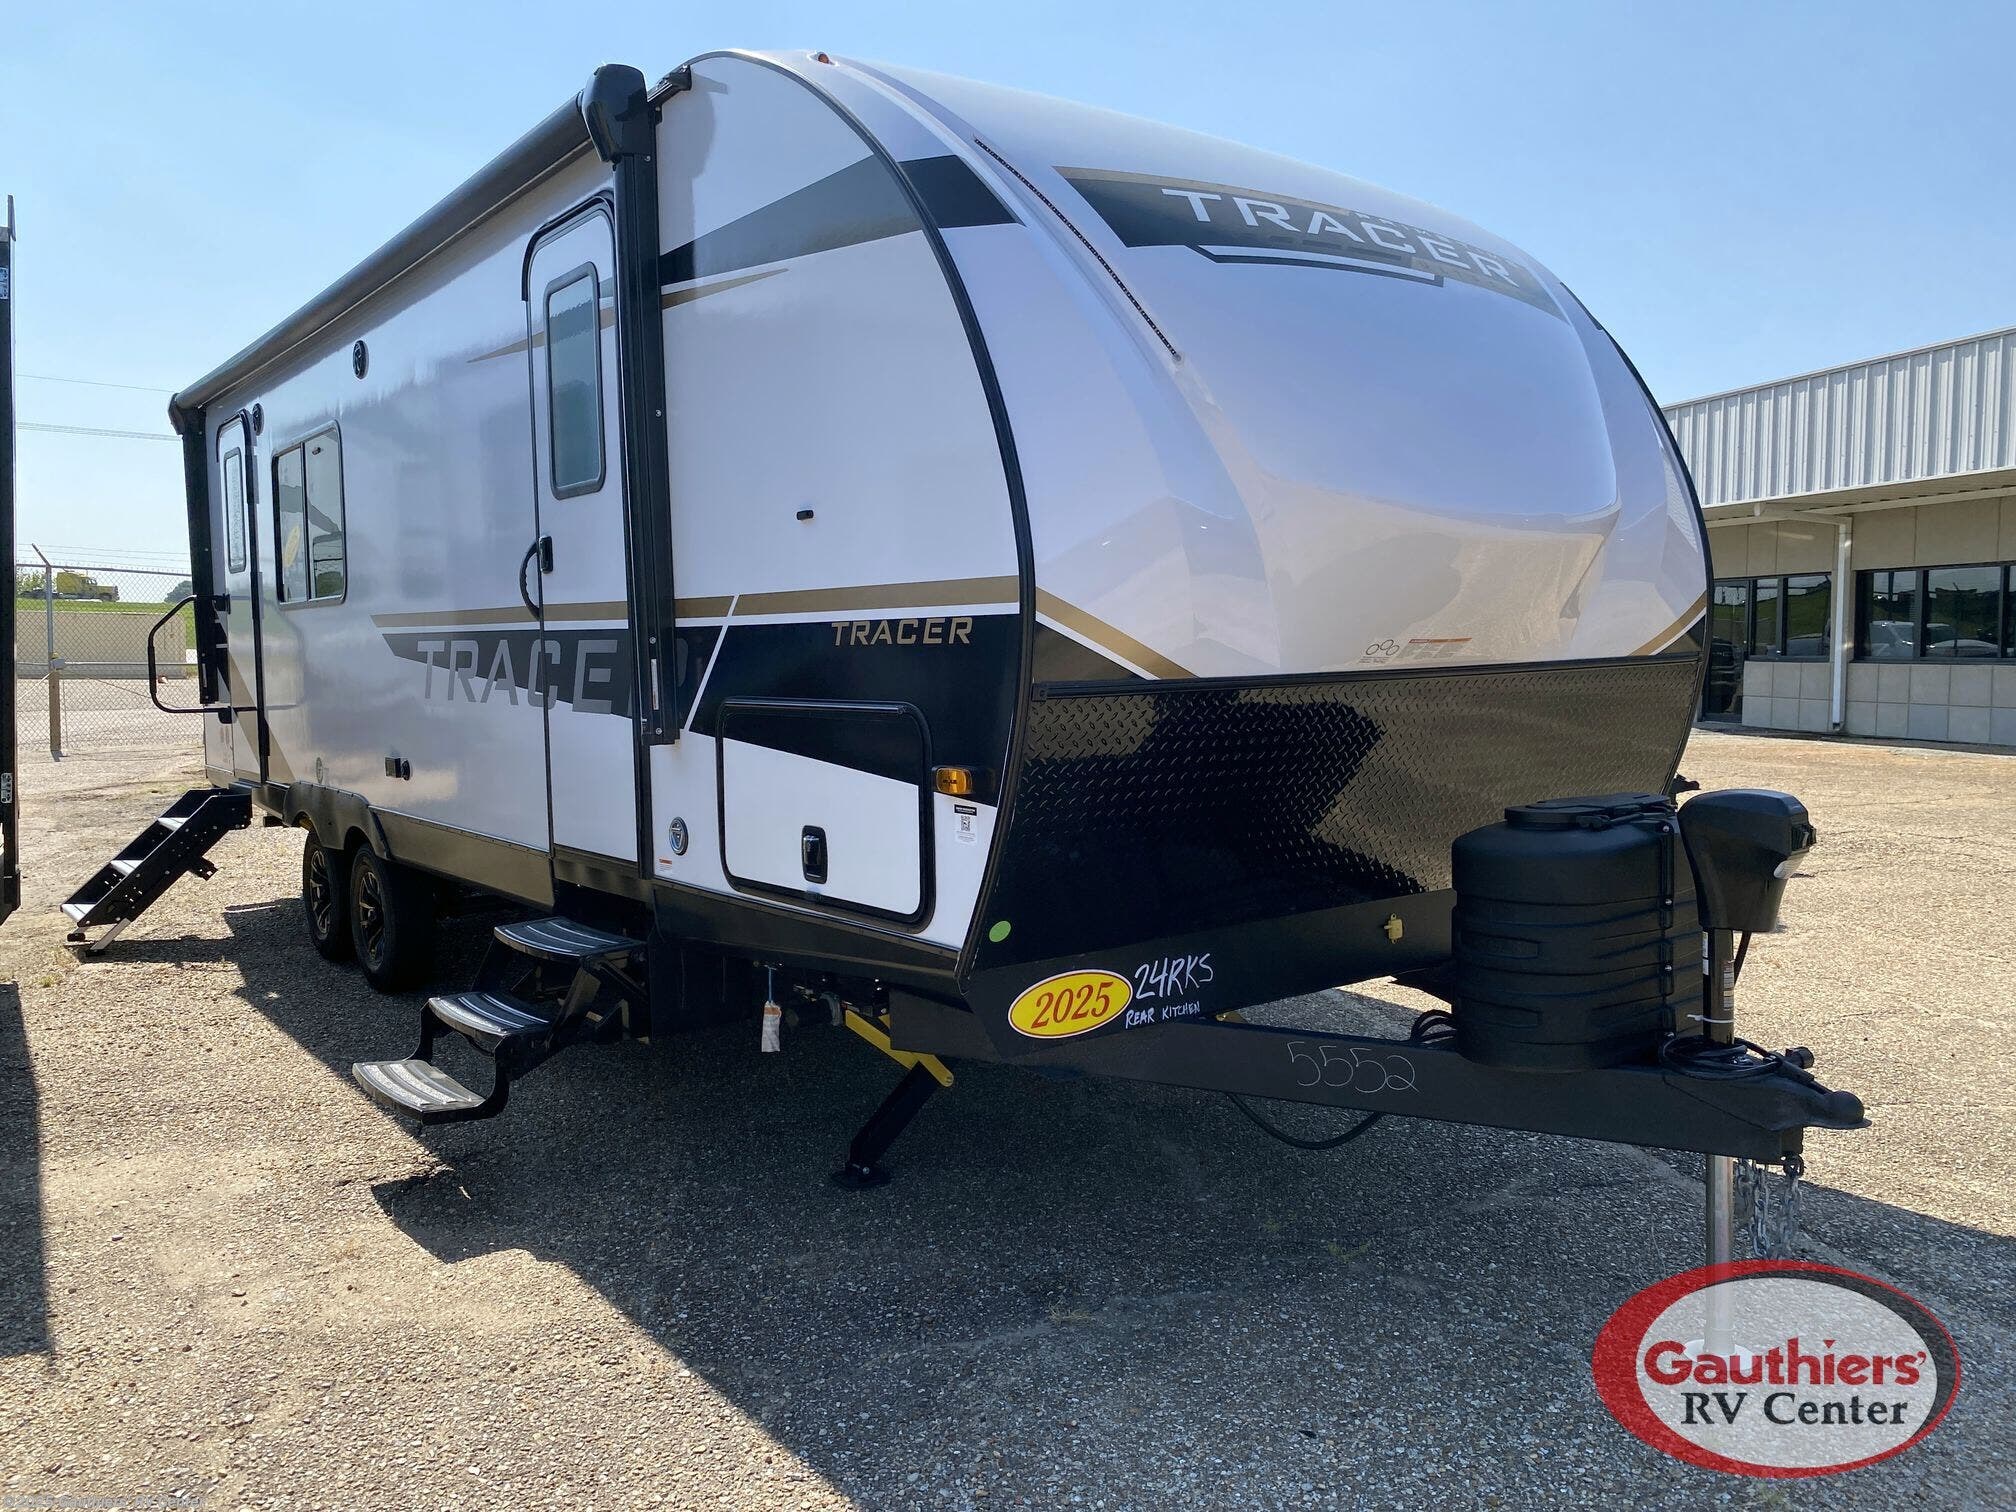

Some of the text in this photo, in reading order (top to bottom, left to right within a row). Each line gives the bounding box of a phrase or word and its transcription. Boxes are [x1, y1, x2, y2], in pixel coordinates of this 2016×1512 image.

[1161, 188, 1519, 288] TRACER
[831, 616, 973, 646] TRACER
[1134, 953, 1214, 999] 24RKS
[1031, 981, 1114, 1029] 2025
[1125, 1001, 1201, 1029] REAR KITCHEN
[1286, 1041, 1420, 1094] 5552
